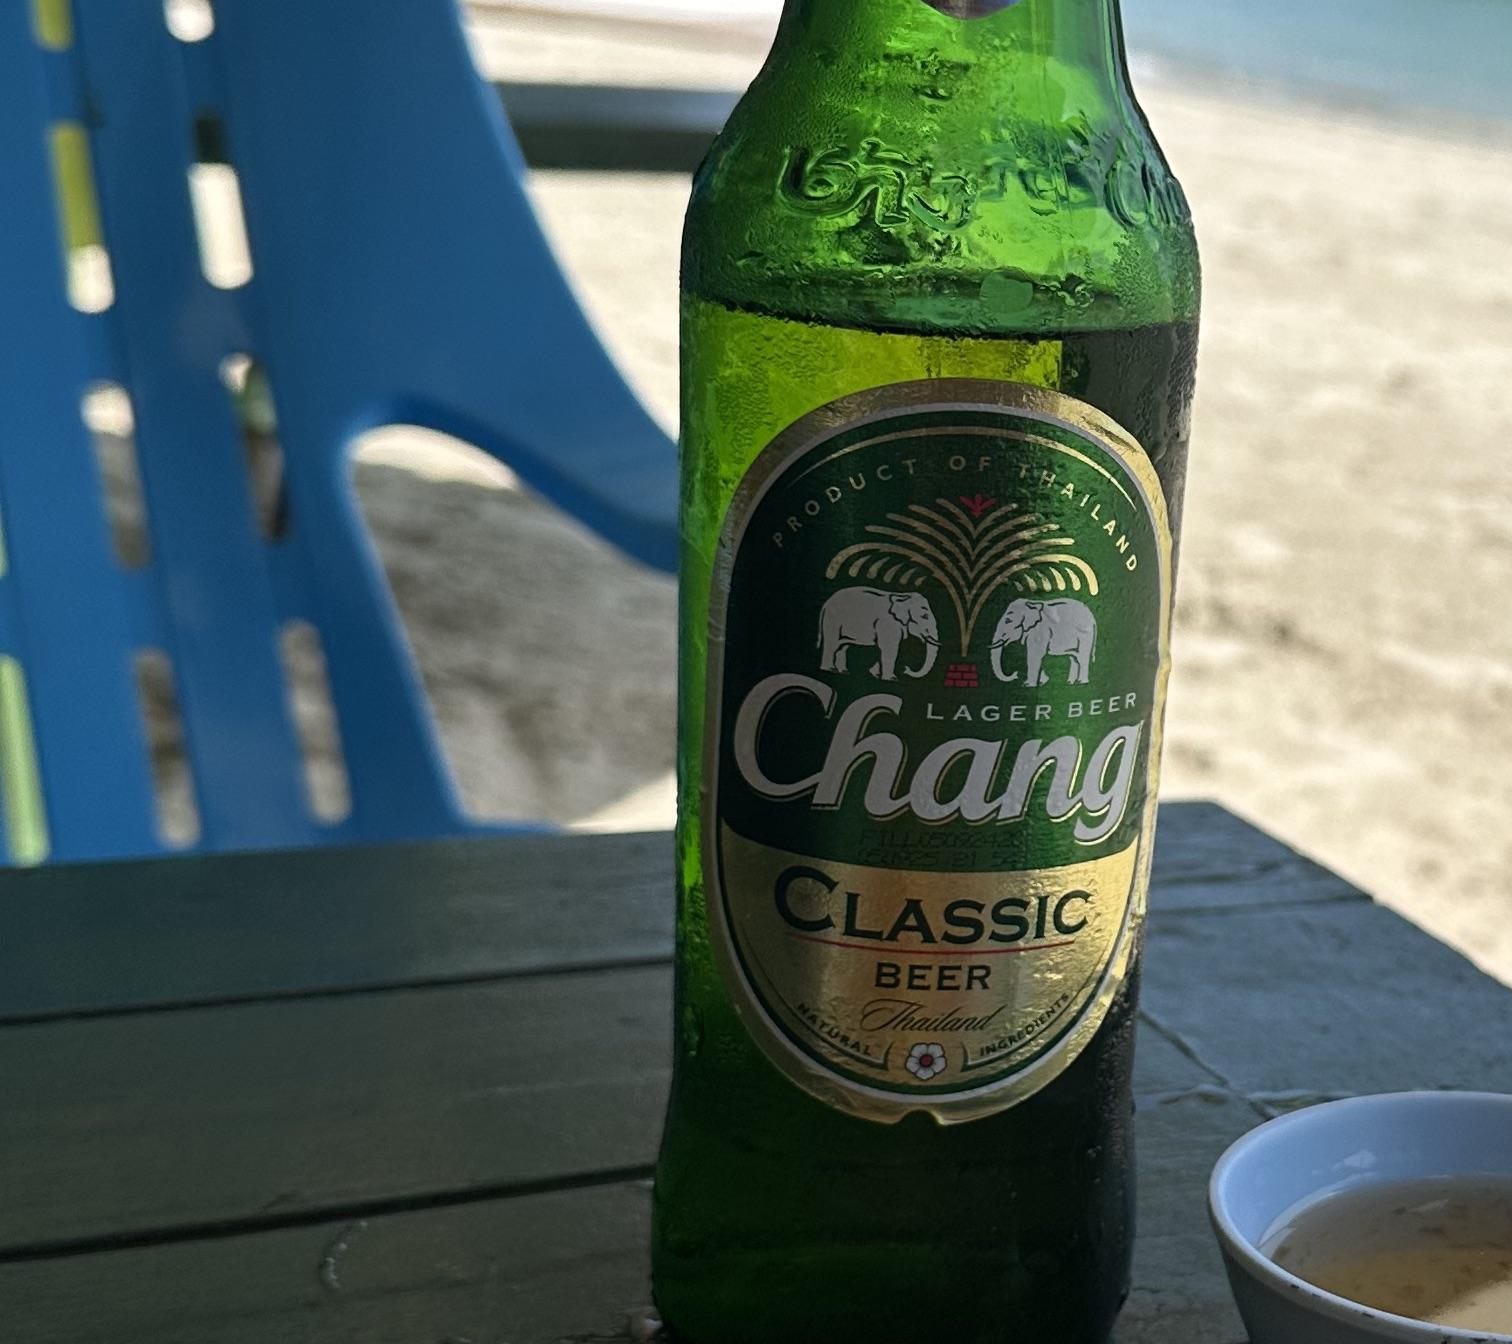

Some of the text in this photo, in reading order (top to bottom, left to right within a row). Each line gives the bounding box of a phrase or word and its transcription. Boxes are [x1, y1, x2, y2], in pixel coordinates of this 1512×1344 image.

[772, 455, 1138, 572] PRODUCT OF THAILAND
[926, 692, 1137, 722] LAGER BEER
[734, 673, 1143, 846] Chang
[774, 865, 1092, 944] CLASSIC
[874, 962, 992, 990] BEER
[797, 991, 1072, 1058] NATURAL INGREDIENTS
[859, 997, 1008, 1033] Thailand
